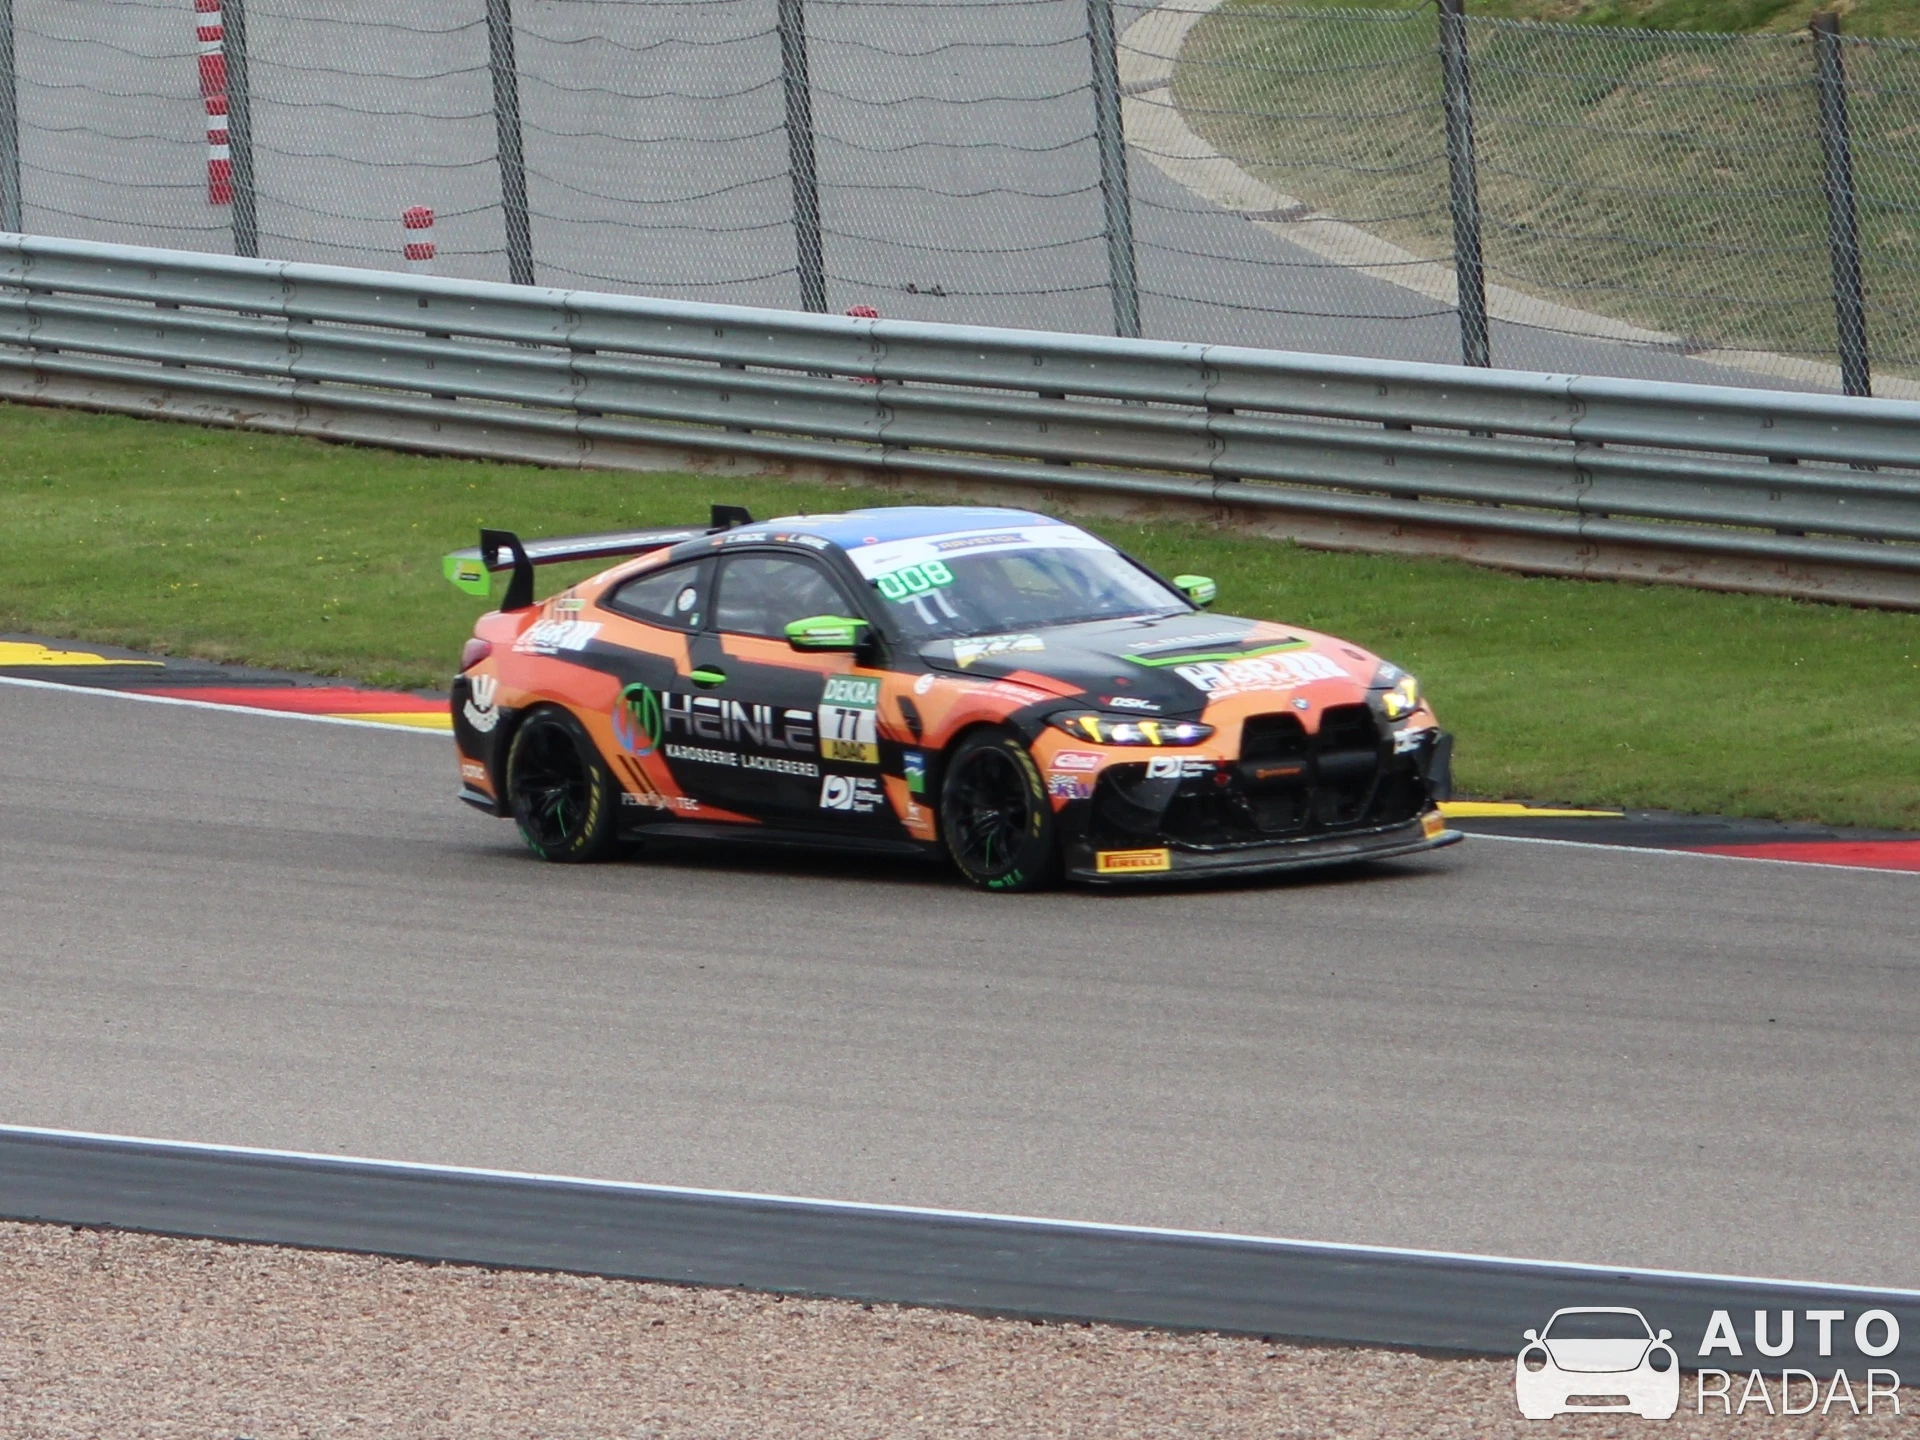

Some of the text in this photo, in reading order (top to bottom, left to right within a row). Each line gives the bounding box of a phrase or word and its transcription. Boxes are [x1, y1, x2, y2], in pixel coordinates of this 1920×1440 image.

[823, 677, 877, 704] DEKRA
[662, 691, 815, 749] HEINLE
[834, 708, 861, 740] 77
[665, 743, 819, 777] KAROSSERIE LACKIEREREI
[832, 740, 867, 760] ADAC
[1106, 853, 1163, 869] PIRELLI
